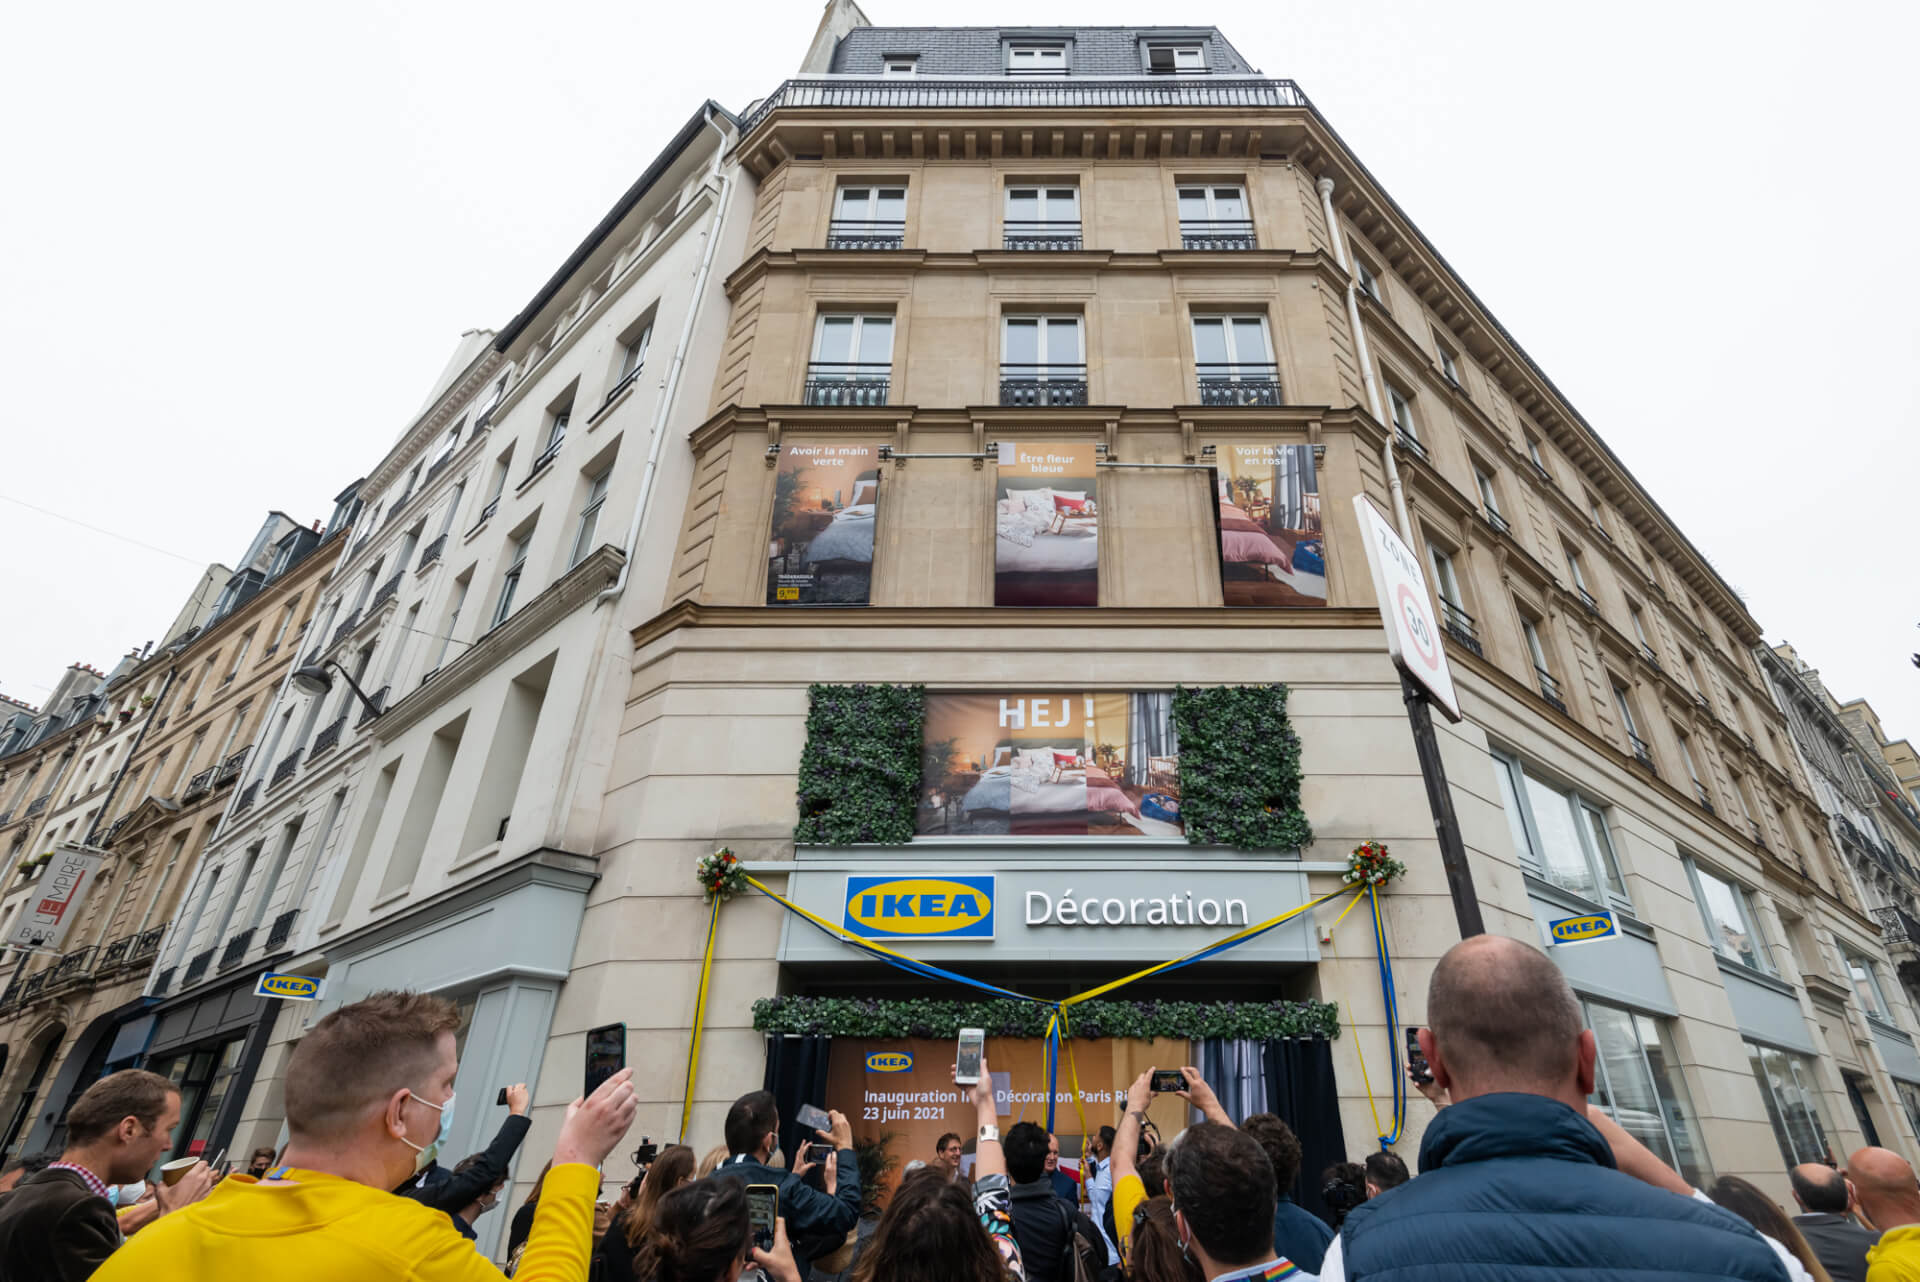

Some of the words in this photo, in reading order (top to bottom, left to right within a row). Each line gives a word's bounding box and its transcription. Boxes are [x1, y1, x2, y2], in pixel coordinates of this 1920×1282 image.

[790, 447, 822, 456] Avoir
[824, 447, 835, 456] la
[838, 447, 869, 456] main
[1020, 451, 1044, 464] Être
[1046, 453, 1075, 464] fleur
[1236, 447, 1259, 456] Voir
[1263, 447, 1273, 456] la
[1276, 447, 1294, 456] vie
[812, 457, 845, 466] verte
[1031, 463, 1064, 473] bleue
[1263, 457, 1287, 465] rose
[1407, 606, 1430, 647] 30
[999, 699, 1070, 727] HEJ
[32, 856, 86, 925] L'EMPIRE
[861, 894, 982, 917] IKEA
[1024, 888, 1249, 926] Décoration
[20, 927, 55, 942] BAR
[1557, 920, 1608, 937] IKEA
[267, 979, 313, 992] IKEA
[871, 1058, 909, 1066] IKEA
[864, 1089, 957, 1106] Inauguration
[996, 1089, 1073, 1103] Décoraton
[1077, 1089, 1112, 1103] Paris
[863, 1107, 880, 1120] 23
[881, 1106, 910, 1124] juin
[913, 1107, 945, 1120] 2021
